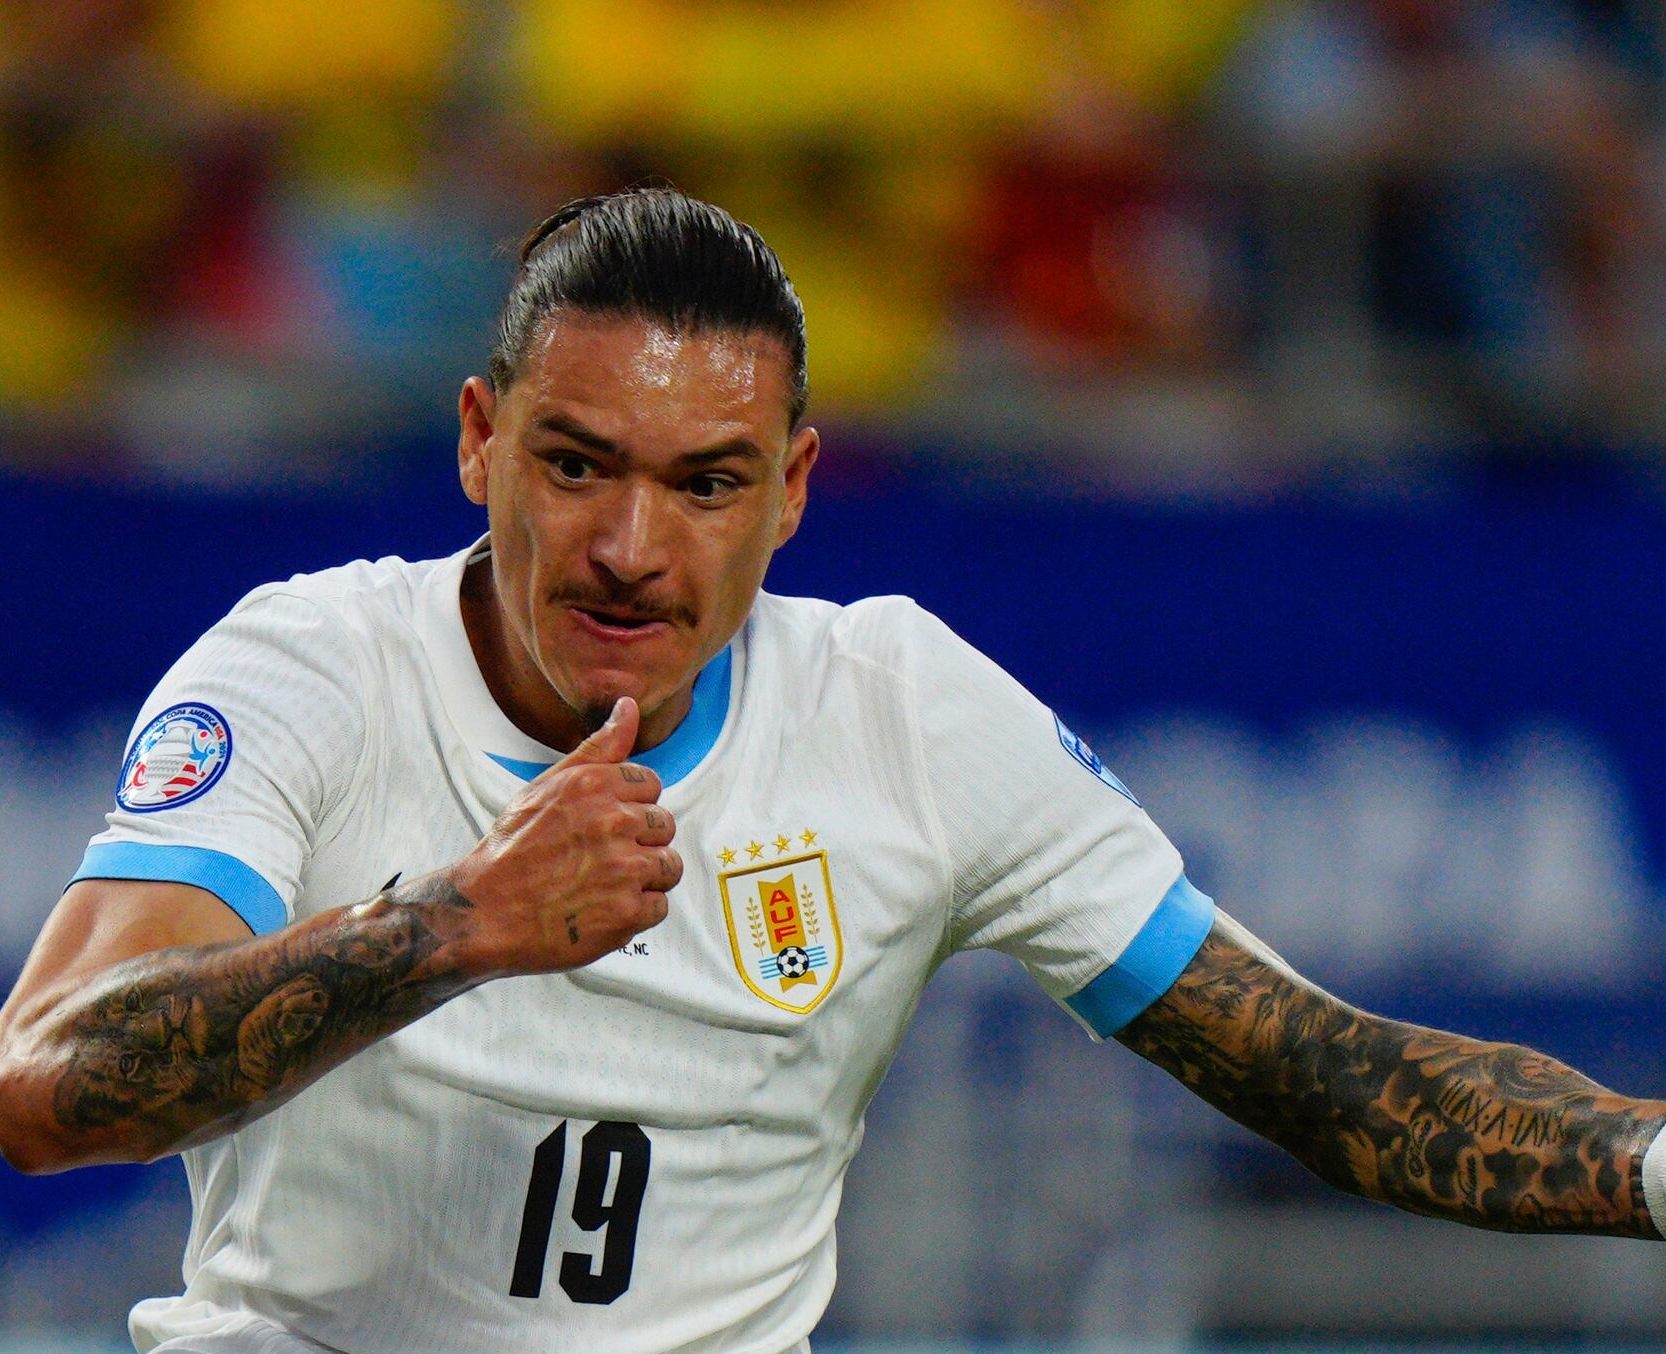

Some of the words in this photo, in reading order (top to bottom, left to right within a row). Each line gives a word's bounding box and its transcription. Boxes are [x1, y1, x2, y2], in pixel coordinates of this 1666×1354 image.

[166, 708, 186, 720] COPA
[769, 888, 798, 943] AUF
[633, 942, 649, 956] NC
[508, 1118, 652, 1305] 19
